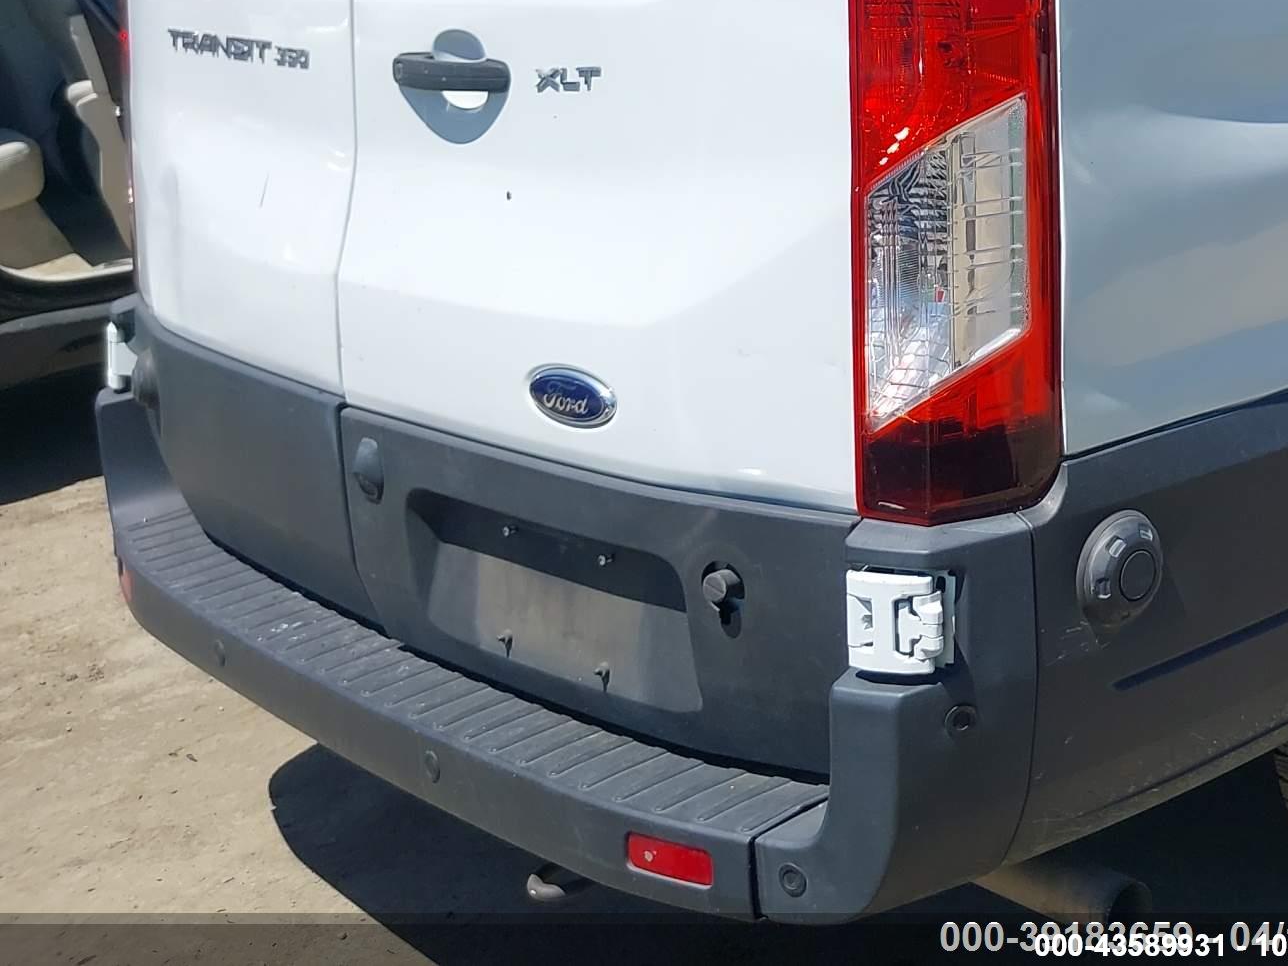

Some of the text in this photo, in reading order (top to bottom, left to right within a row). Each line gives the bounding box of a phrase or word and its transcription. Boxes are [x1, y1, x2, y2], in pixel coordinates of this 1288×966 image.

[167, 28, 310, 70] TRANSIT 350
[535, 66, 602, 93] XLT
[543, 380, 589, 415] Ford
